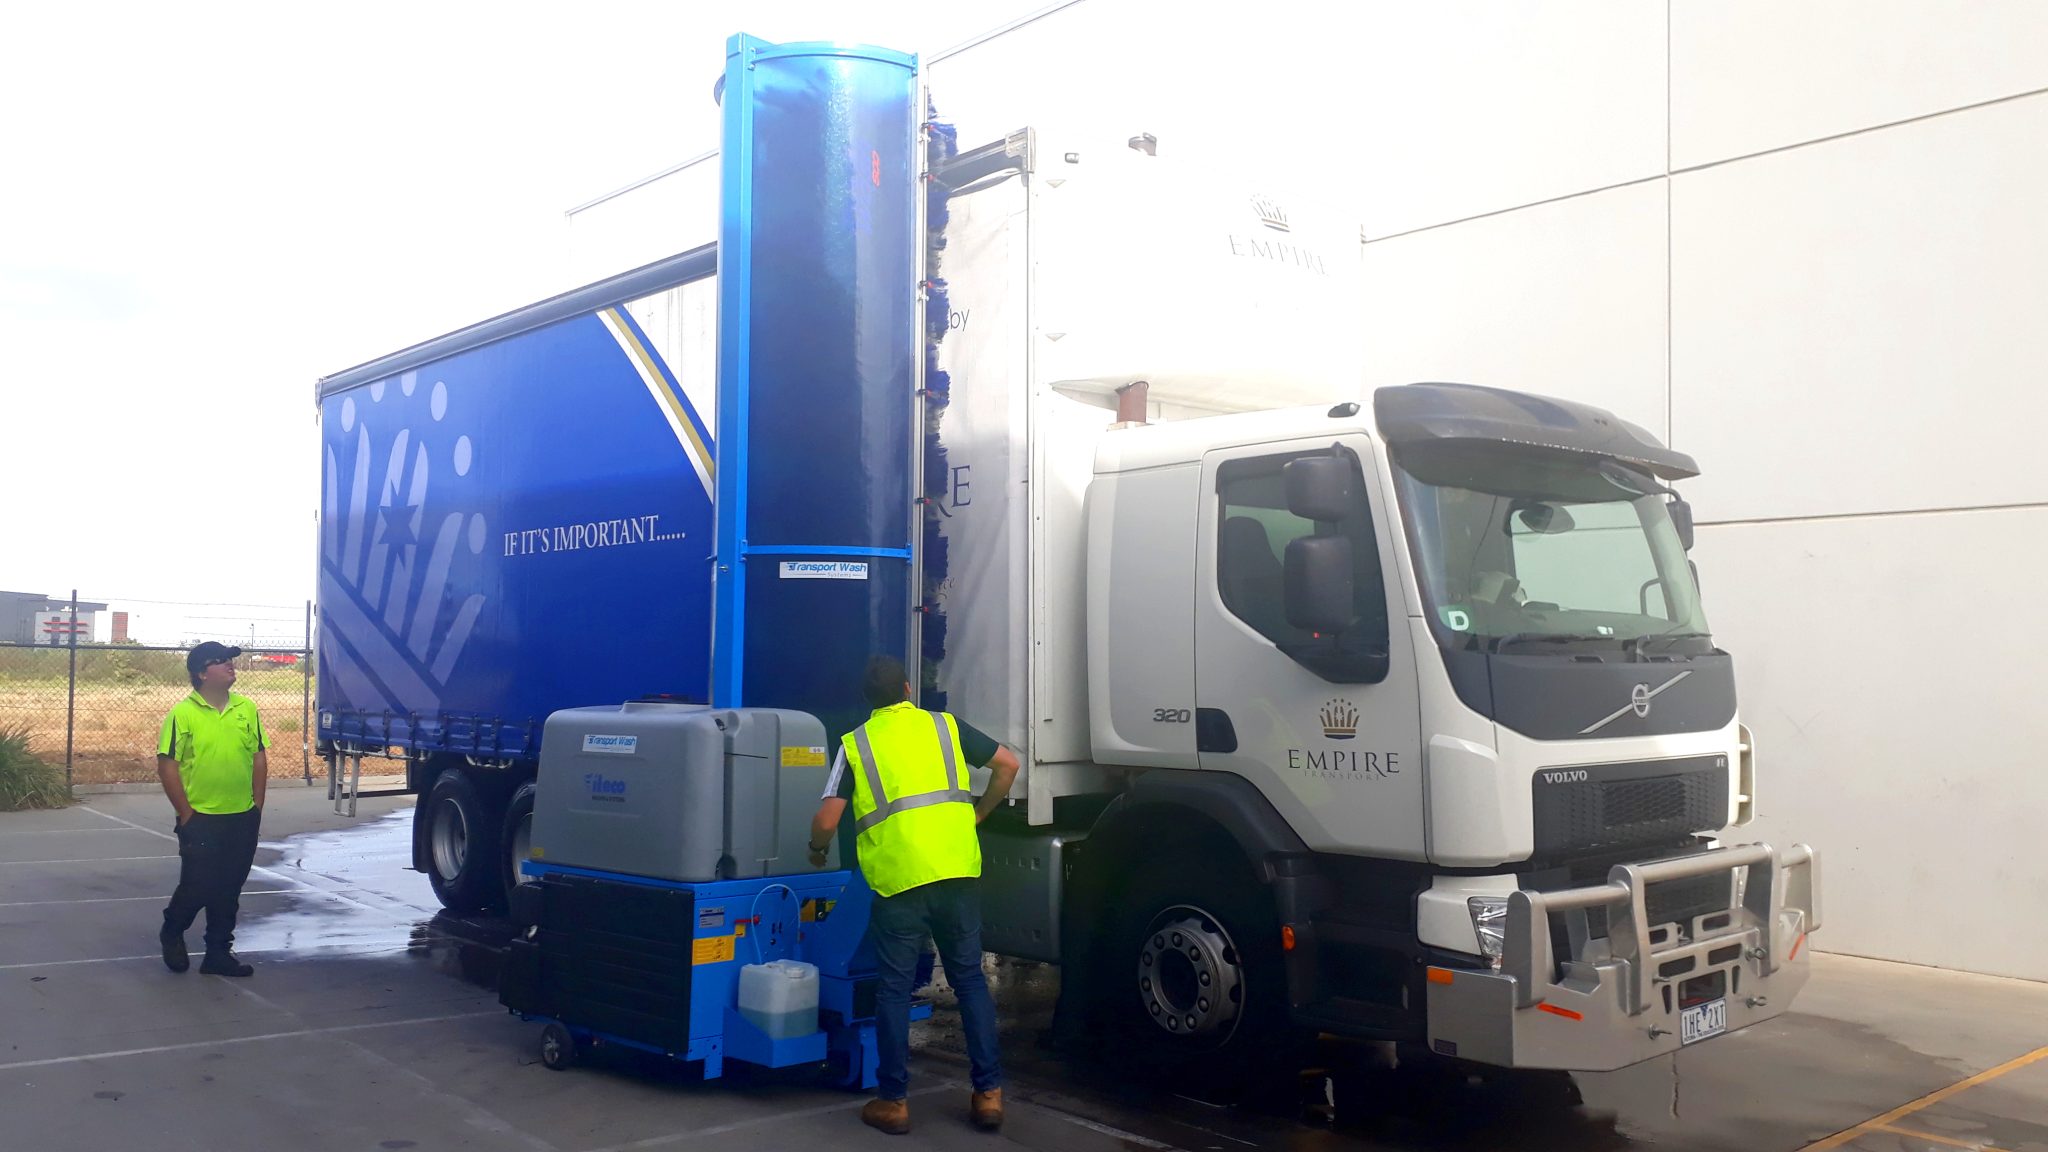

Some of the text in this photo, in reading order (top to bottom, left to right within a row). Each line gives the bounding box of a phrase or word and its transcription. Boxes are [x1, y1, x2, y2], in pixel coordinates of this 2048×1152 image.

[1228, 234, 1330, 278] EMPIRE
[504, 532, 518, 556] IF
[521, 528, 550, 554] IT'S
[787, 562, 867, 572] Transport Wash
[1448, 610, 1470, 631] D
[1153, 708, 1191, 723] 320
[588, 736, 636, 746] Transport Wash
[1288, 749, 1400, 777] EMPIRE
[1304, 770, 1380, 781] TRANSPORT
[1543, 770, 1588, 784] VOLVO
